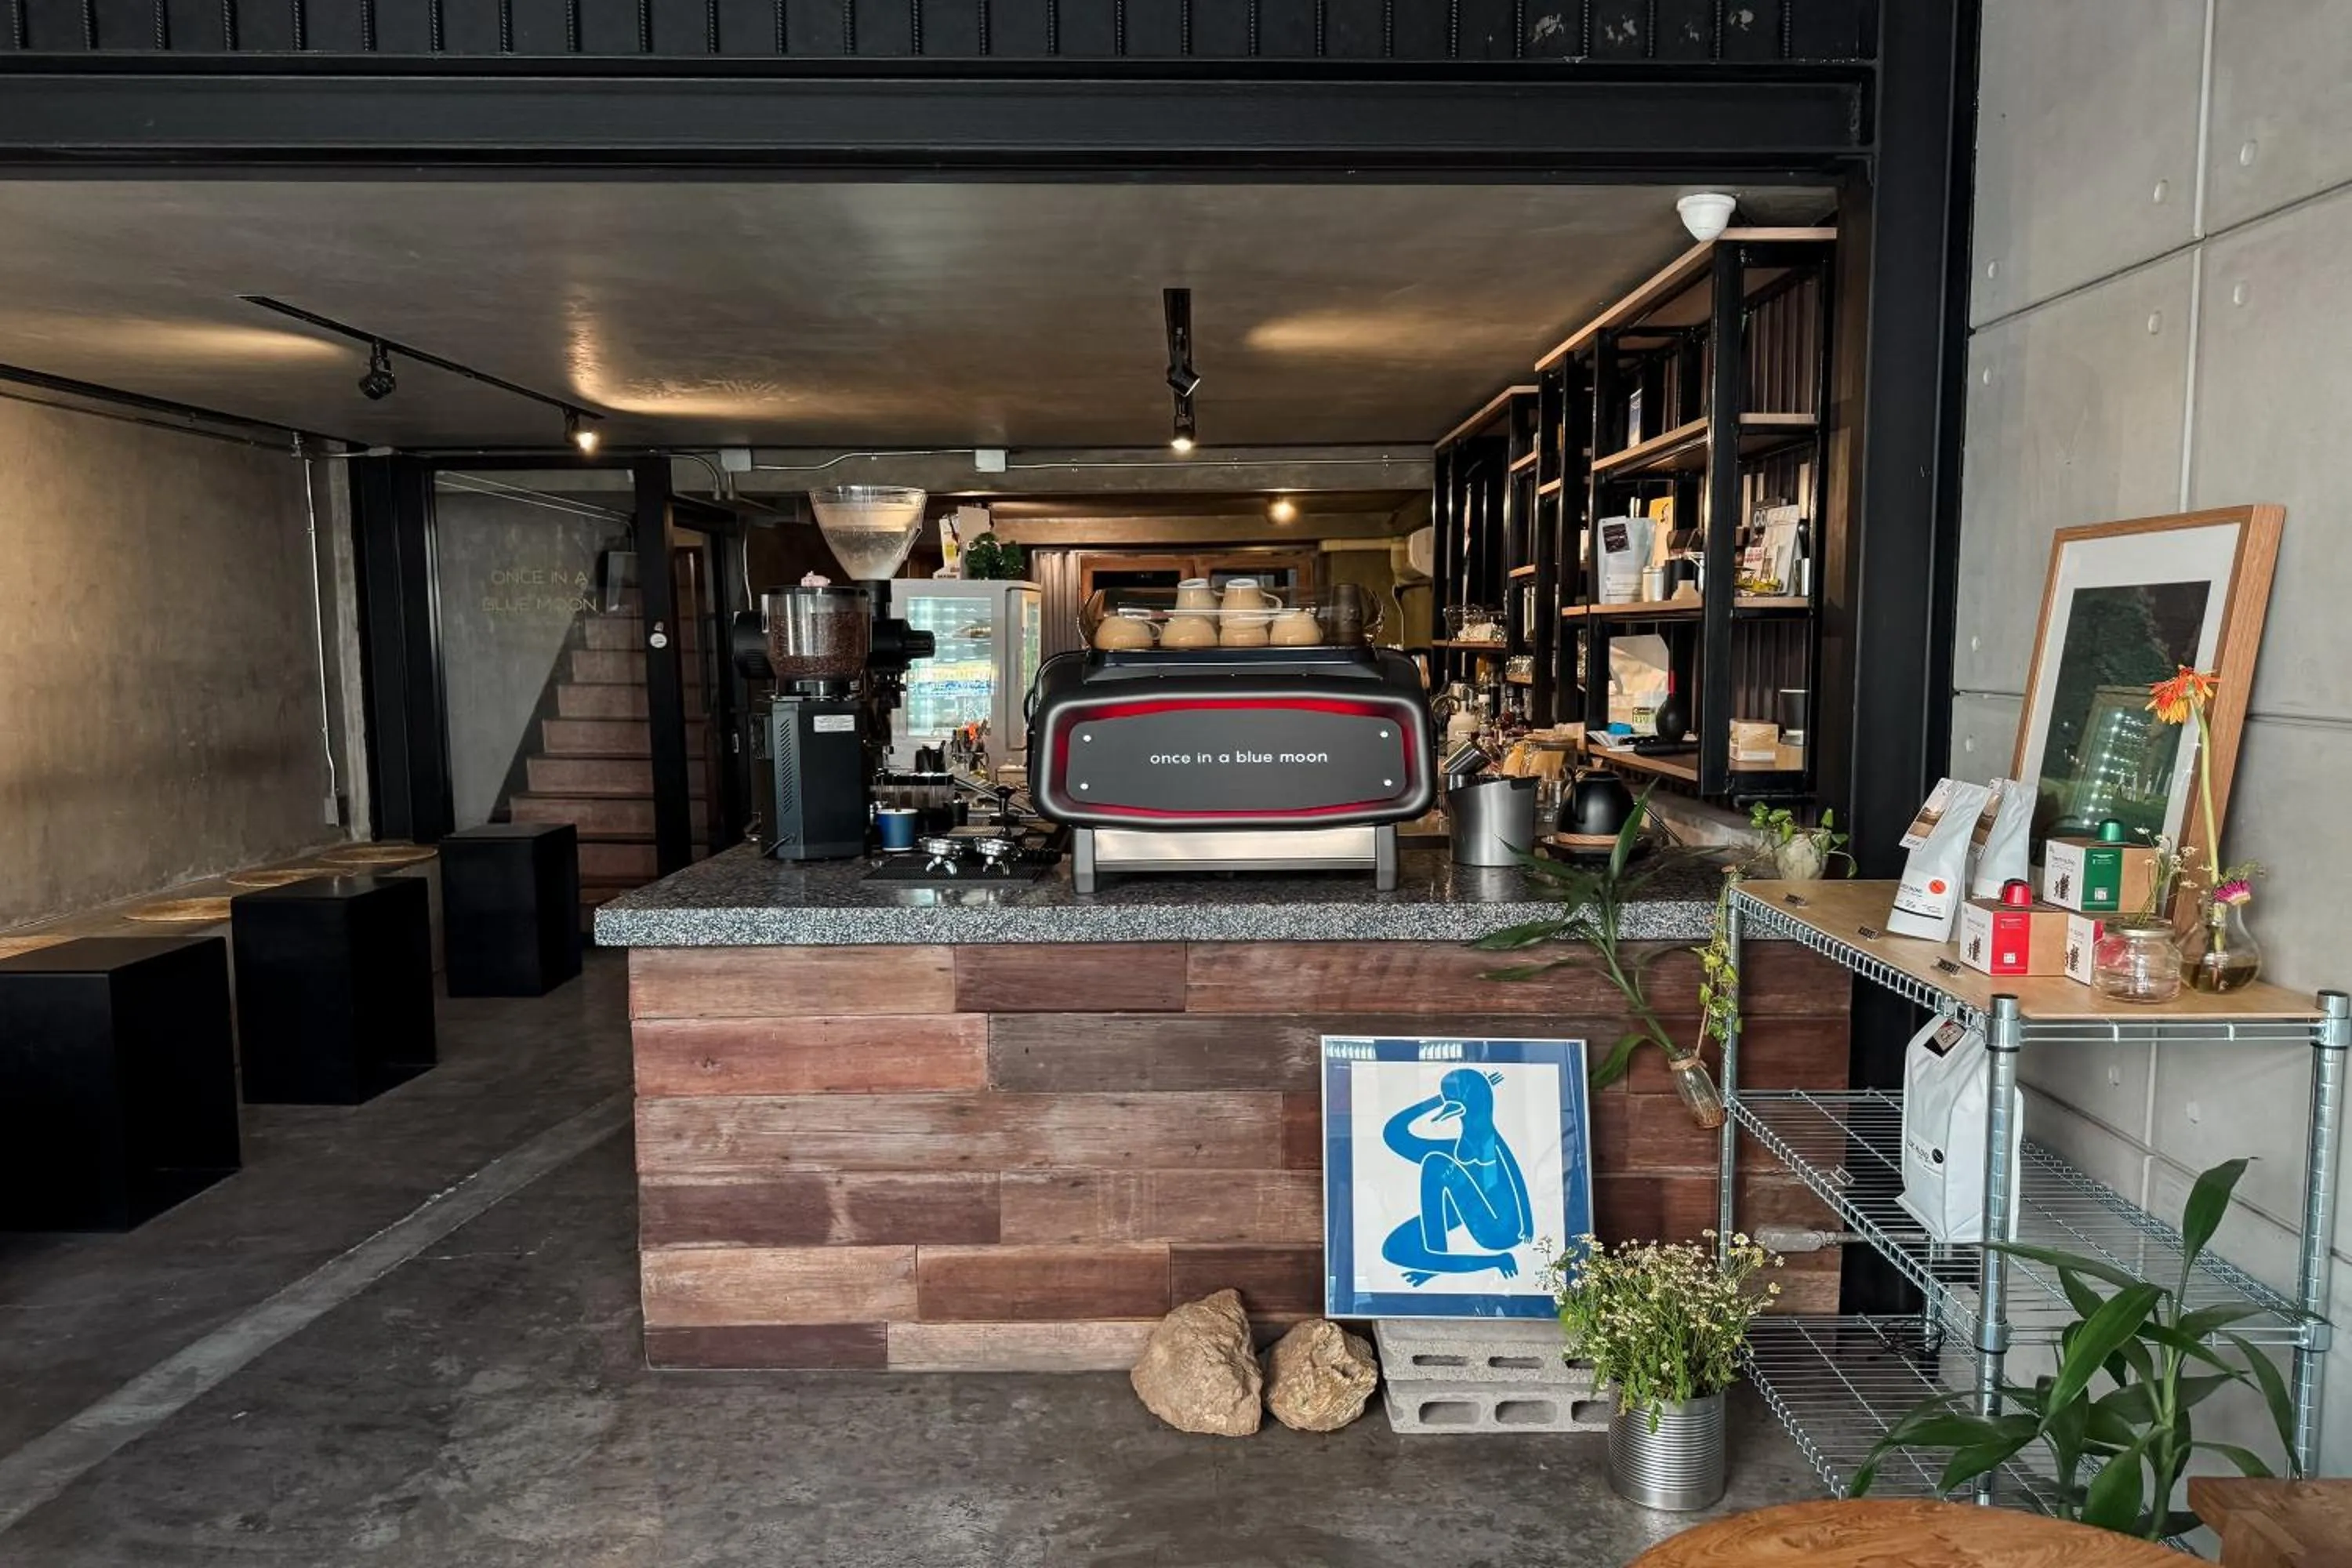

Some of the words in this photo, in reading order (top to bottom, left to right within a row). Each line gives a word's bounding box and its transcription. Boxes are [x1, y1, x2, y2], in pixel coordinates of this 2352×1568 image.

[490, 570, 545, 585] ONCE
[550, 570, 568, 584] IN
[575, 571, 588, 585] A
[483, 597, 529, 612] BLUE
[536, 597, 597, 612] MOON
[1149, 753, 1191, 764] once
[1197, 752, 1212, 763] in
[1218, 753, 1230, 763] a
[1236, 750, 1273, 763] blue
[1279, 753, 1329, 763] moon
